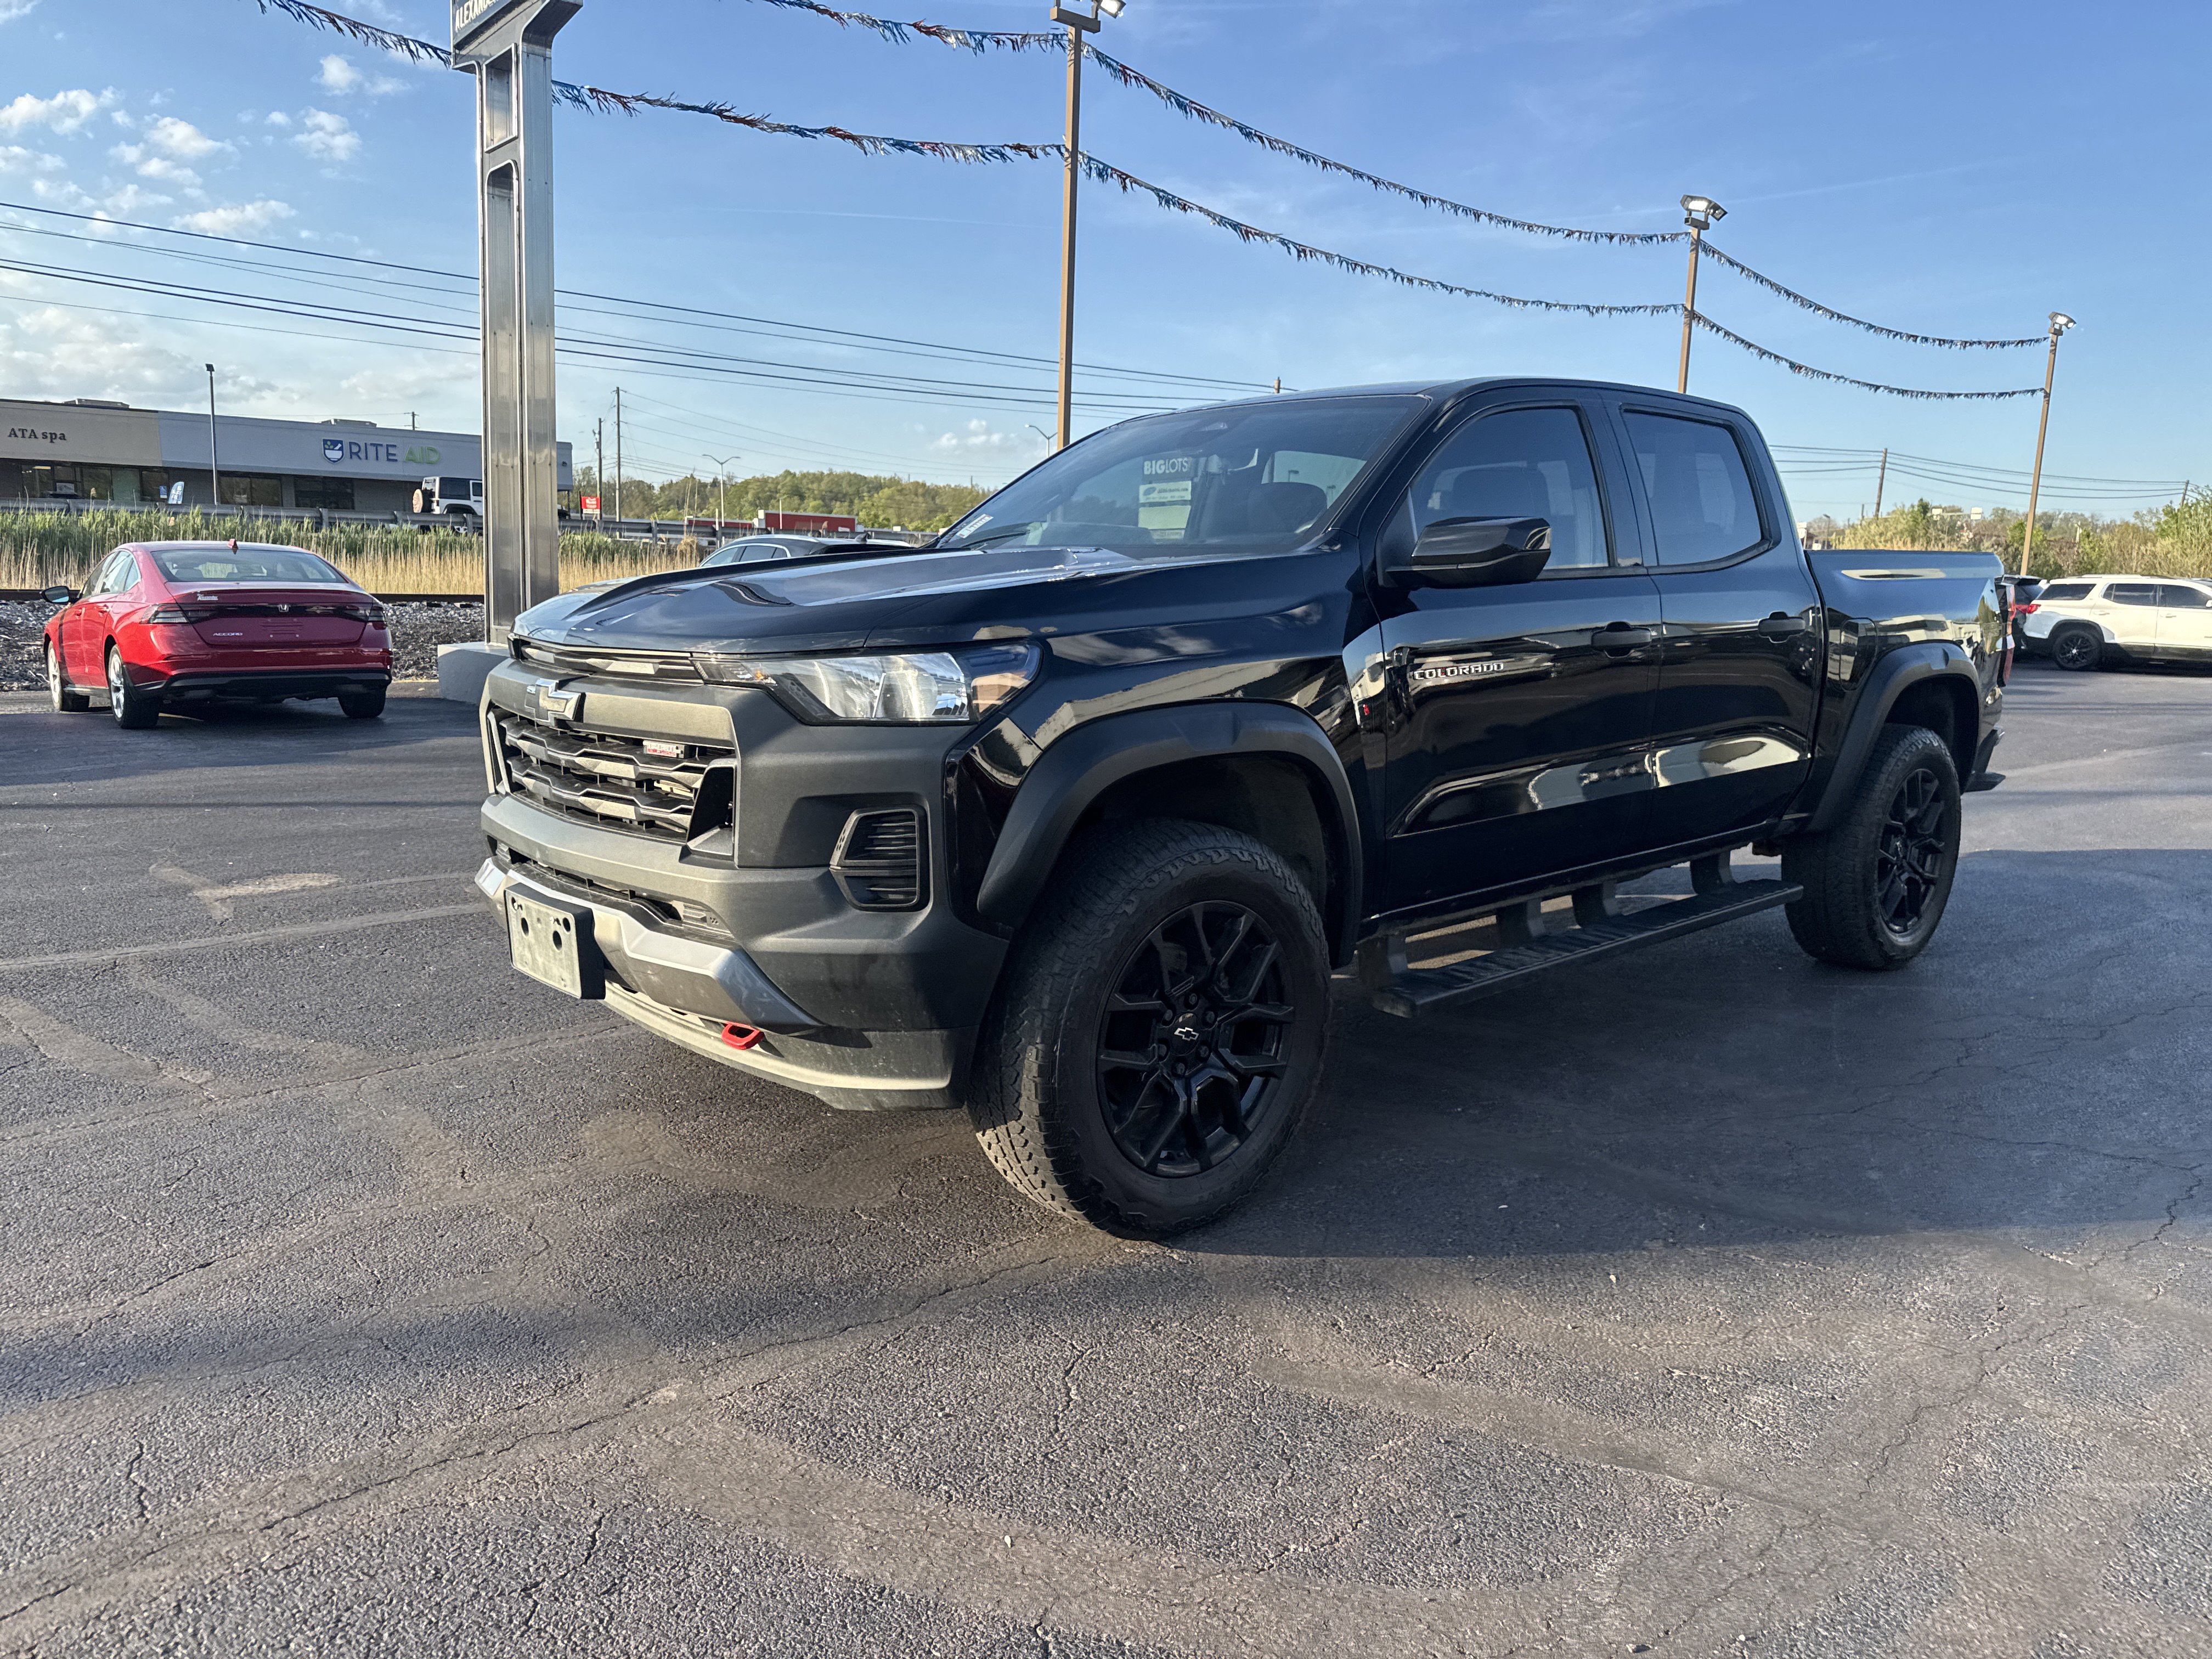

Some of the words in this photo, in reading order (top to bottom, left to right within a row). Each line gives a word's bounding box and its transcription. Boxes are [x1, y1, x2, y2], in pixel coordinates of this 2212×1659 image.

[455, 0, 498, 33] ALEXAN
[8, 428, 38, 439] ATA
[41, 431, 67, 443] spa
[348, 441, 398, 462] RITE
[403, 446, 440, 464] AID
[1414, 662, 1504, 680] COLORADO
